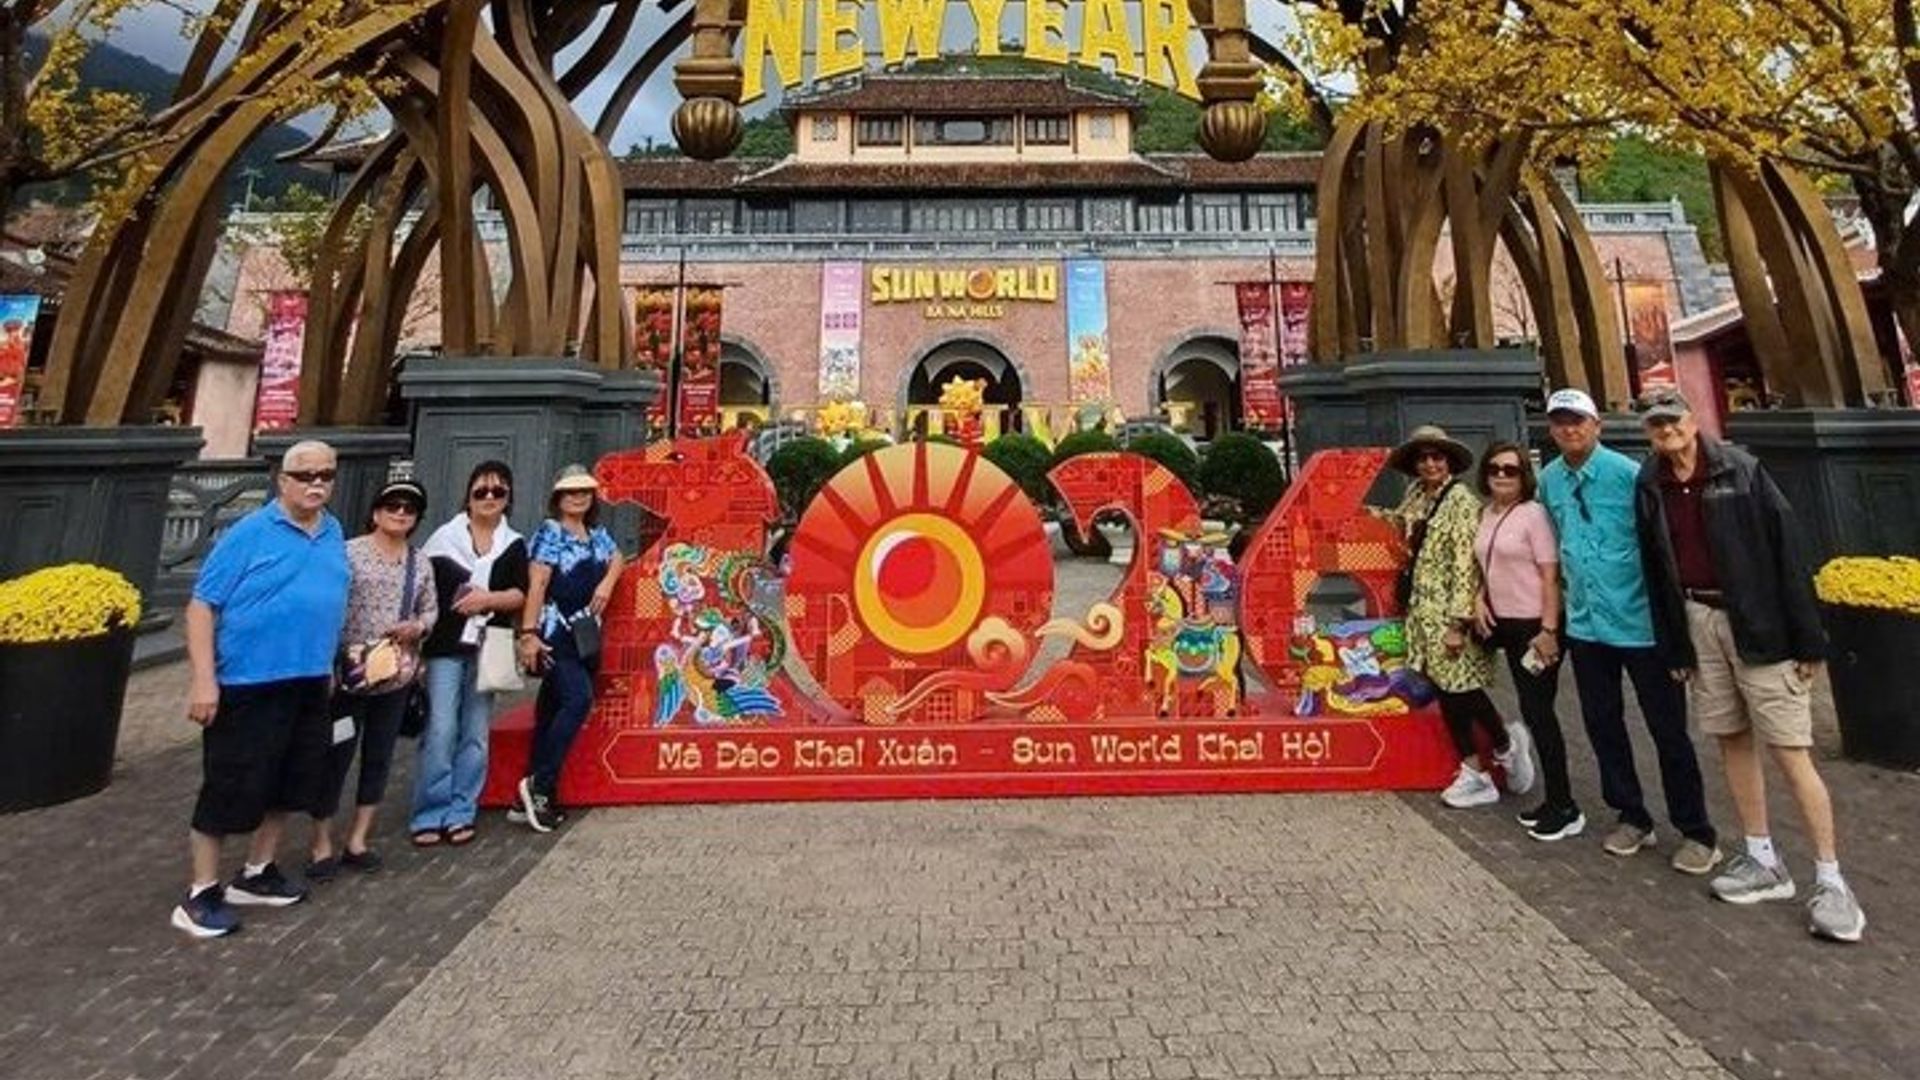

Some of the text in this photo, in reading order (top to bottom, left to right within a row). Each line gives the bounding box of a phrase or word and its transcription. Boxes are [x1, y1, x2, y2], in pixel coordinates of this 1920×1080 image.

[739, 0, 1204, 104] NEW YEAR
[872, 265, 935, 303] SUN
[938, 265, 1057, 302] WORLD
[716, 739, 780, 768] Đáo
[878, 736, 958, 766] Xuân
[1012, 736, 1077, 764] Sun
[1091, 734, 1181, 763] World
